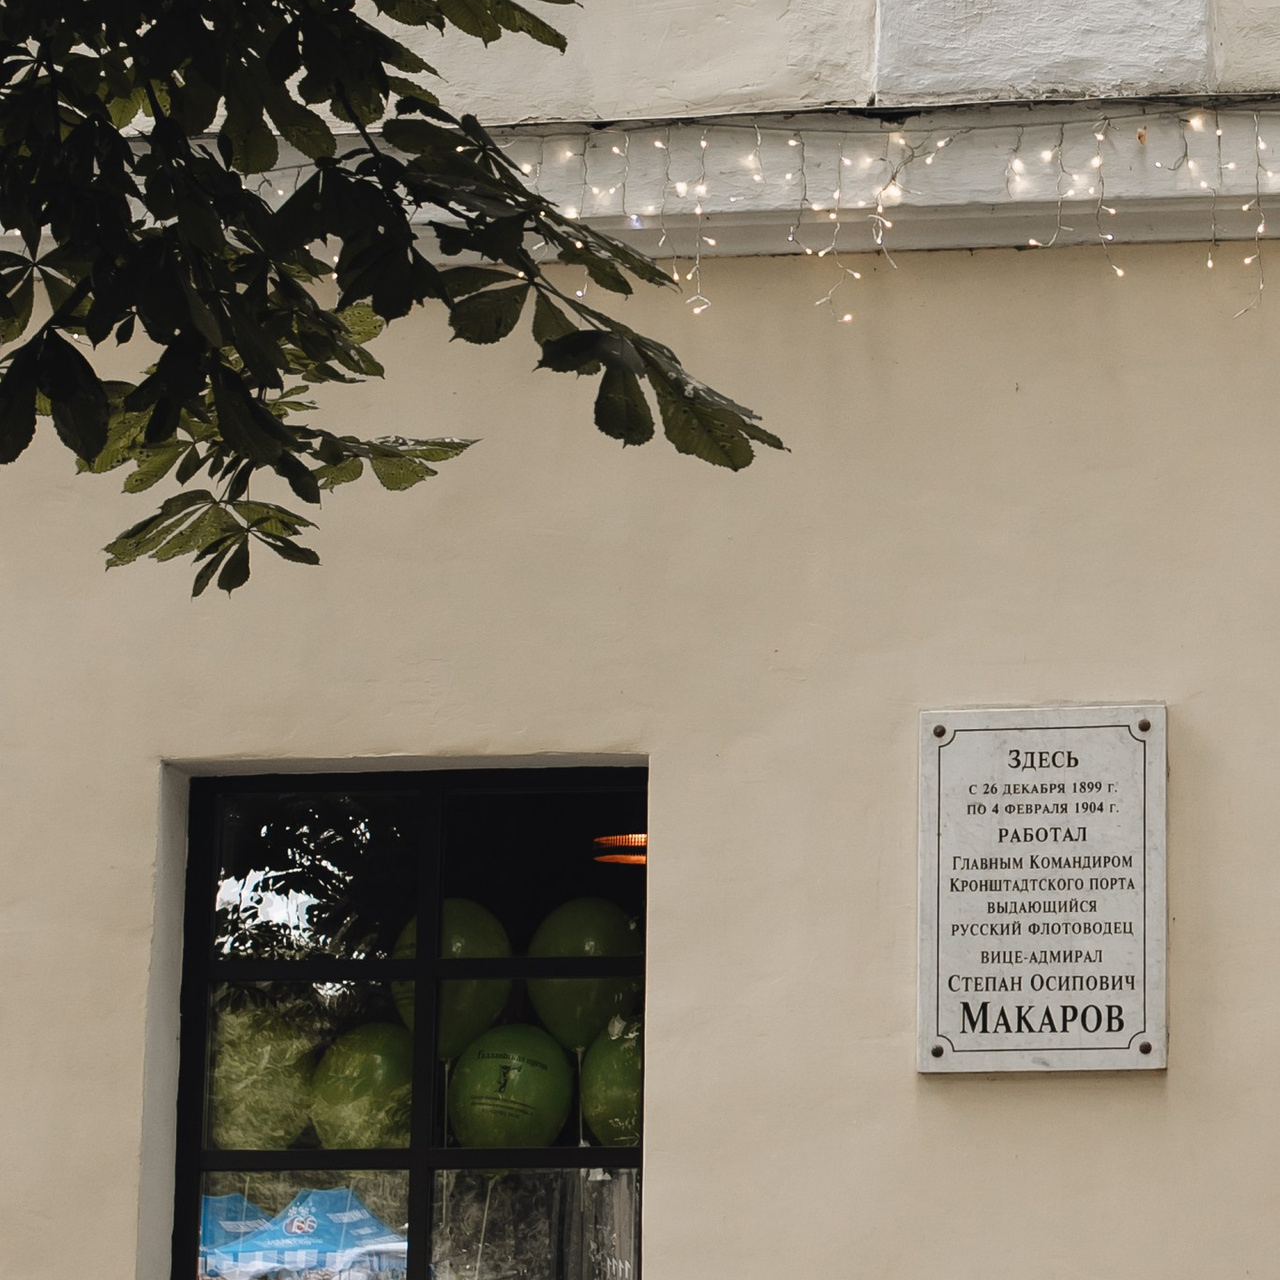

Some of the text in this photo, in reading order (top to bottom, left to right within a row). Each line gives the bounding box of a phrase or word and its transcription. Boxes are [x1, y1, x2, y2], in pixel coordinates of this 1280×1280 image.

[1007, 748, 1080, 772] ЗДЕСЬ
[982, 782, 998, 795] 26
[1002, 782, 1066, 797] ДЕКАБРЯ
[1072, 781, 1103, 794] 1899
[966, 802, 987, 816] ПО
[991, 802, 1000, 815] 4
[1004, 802, 1069, 815] ФЕВРАЛЯ
[1075, 801, 1105, 814] 1904
[997, 826, 1088, 844] РАБОТАЛ
[952, 854, 1133, 871] ГЛАВНЫМ КОМАНДИРОМ
[949, 877, 1136, 894] КРОНШТАДТСКОГО ПОРТА
[986, 898, 1098, 915] ВЫДАЮЩИЙСЯ
[951, 920, 1135, 937] РУССКИЙ ФЛОТОВОДЕЦ
[980, 949, 1103, 966] ВИЦЕ-АДМИРАЛ
[947, 973, 1136, 993] СТЕПАН ОСИПОВИЧ
[959, 1001, 1125, 1034] МАКАРОВ
